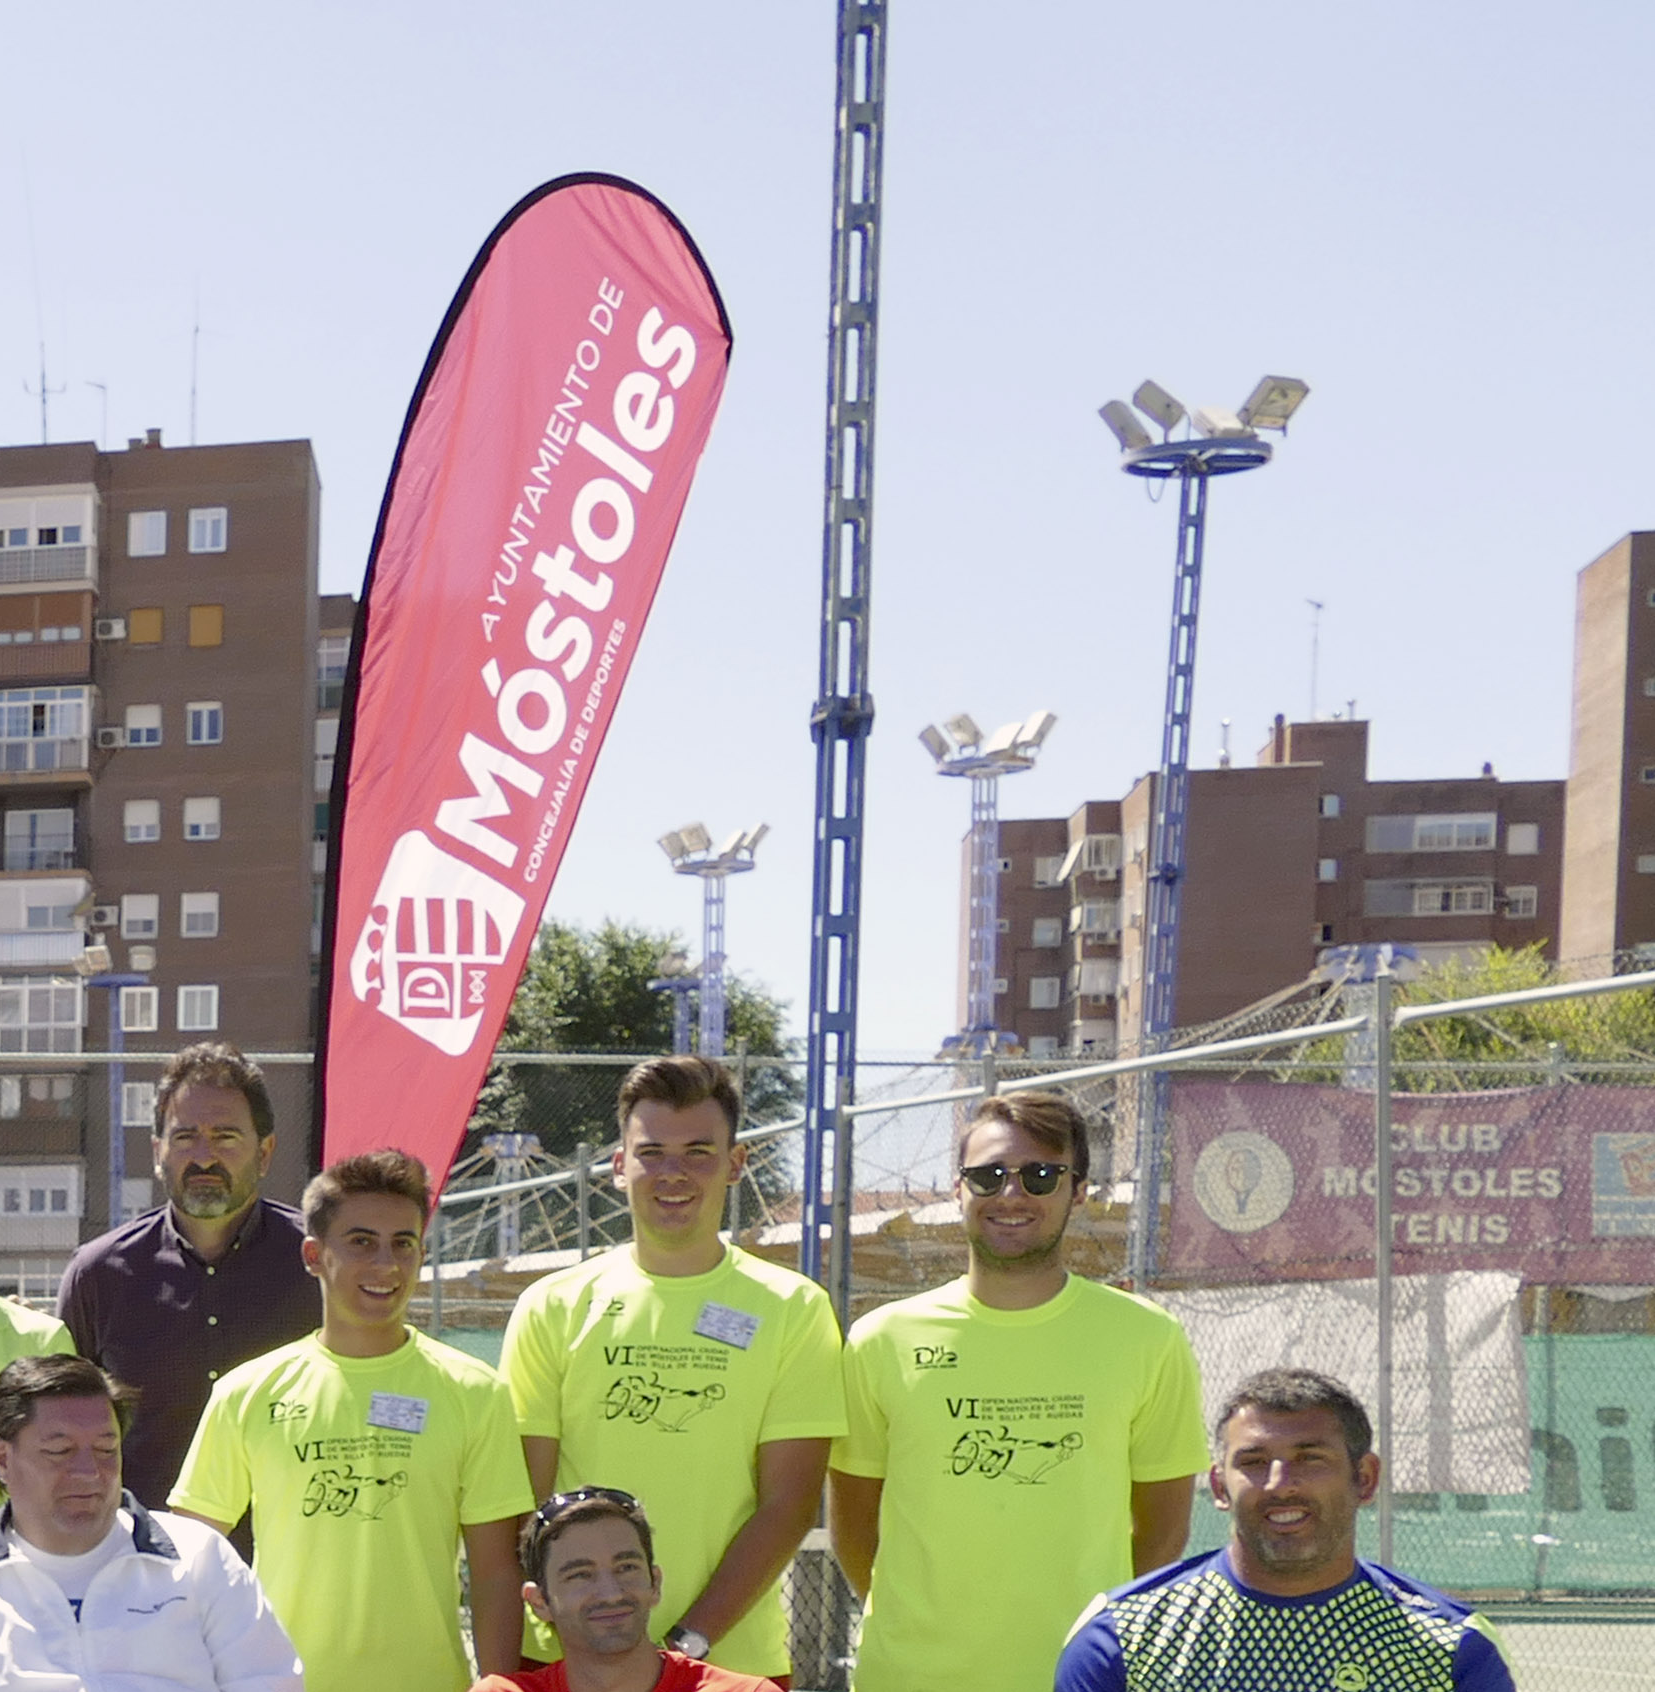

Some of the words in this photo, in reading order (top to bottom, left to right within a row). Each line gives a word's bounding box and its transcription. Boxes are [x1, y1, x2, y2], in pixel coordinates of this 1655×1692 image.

[481, 339, 601, 643] AYUNTAMIENTO
[588, 276, 625, 336] DE
[434, 304, 697, 869] Móstoles
[569, 723, 590, 755] DE
[580, 618, 626, 724] DEPORTES
[604, 1346, 634, 1366] VI
[946, 1397, 980, 1419] VI
[294, 1441, 325, 1463] VI
